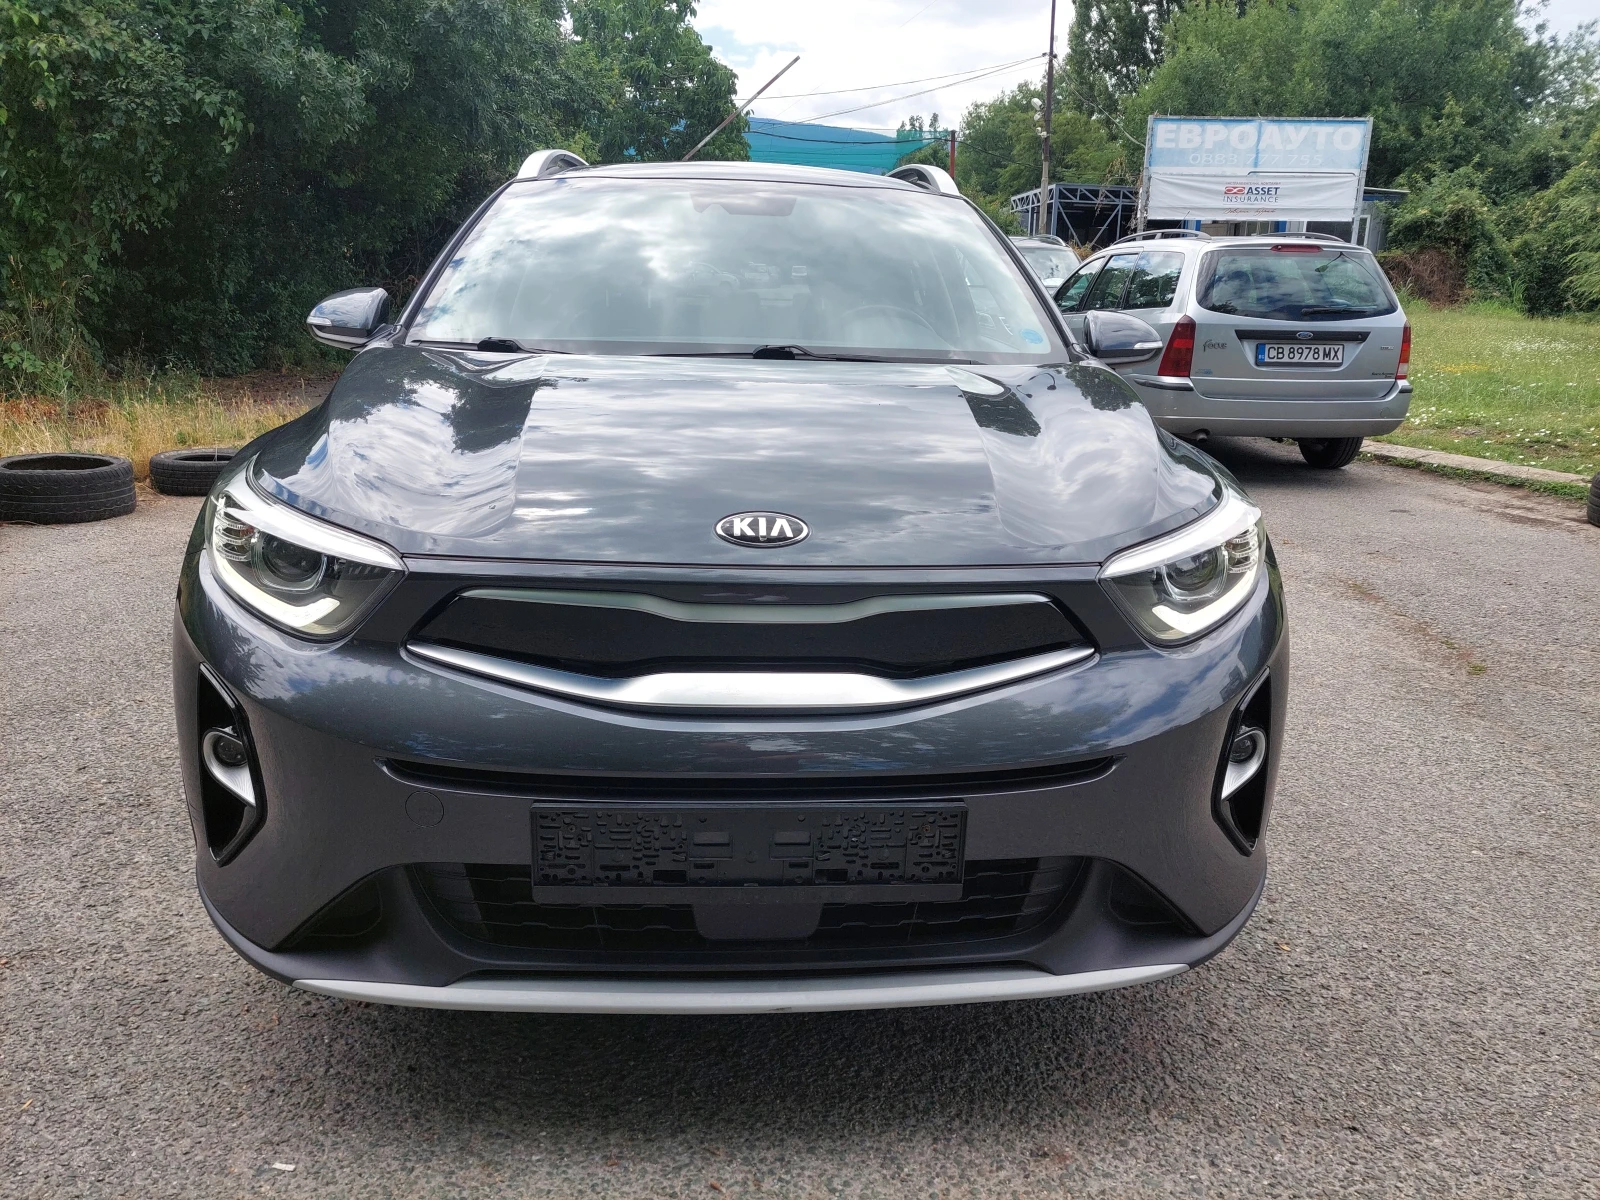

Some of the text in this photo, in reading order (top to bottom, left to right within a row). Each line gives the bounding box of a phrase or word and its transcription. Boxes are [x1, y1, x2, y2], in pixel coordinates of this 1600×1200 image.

[1156, 123, 1362, 151] ЕВРОАУТО
[1189, 153, 1323, 166] 0883 777 755
[1246, 186, 1281, 195] ASSET
[1223, 195, 1279, 203] INSURANCE
[1267, 346, 1341, 361] CB 8978 MX
[733, 517, 794, 538] KIA
